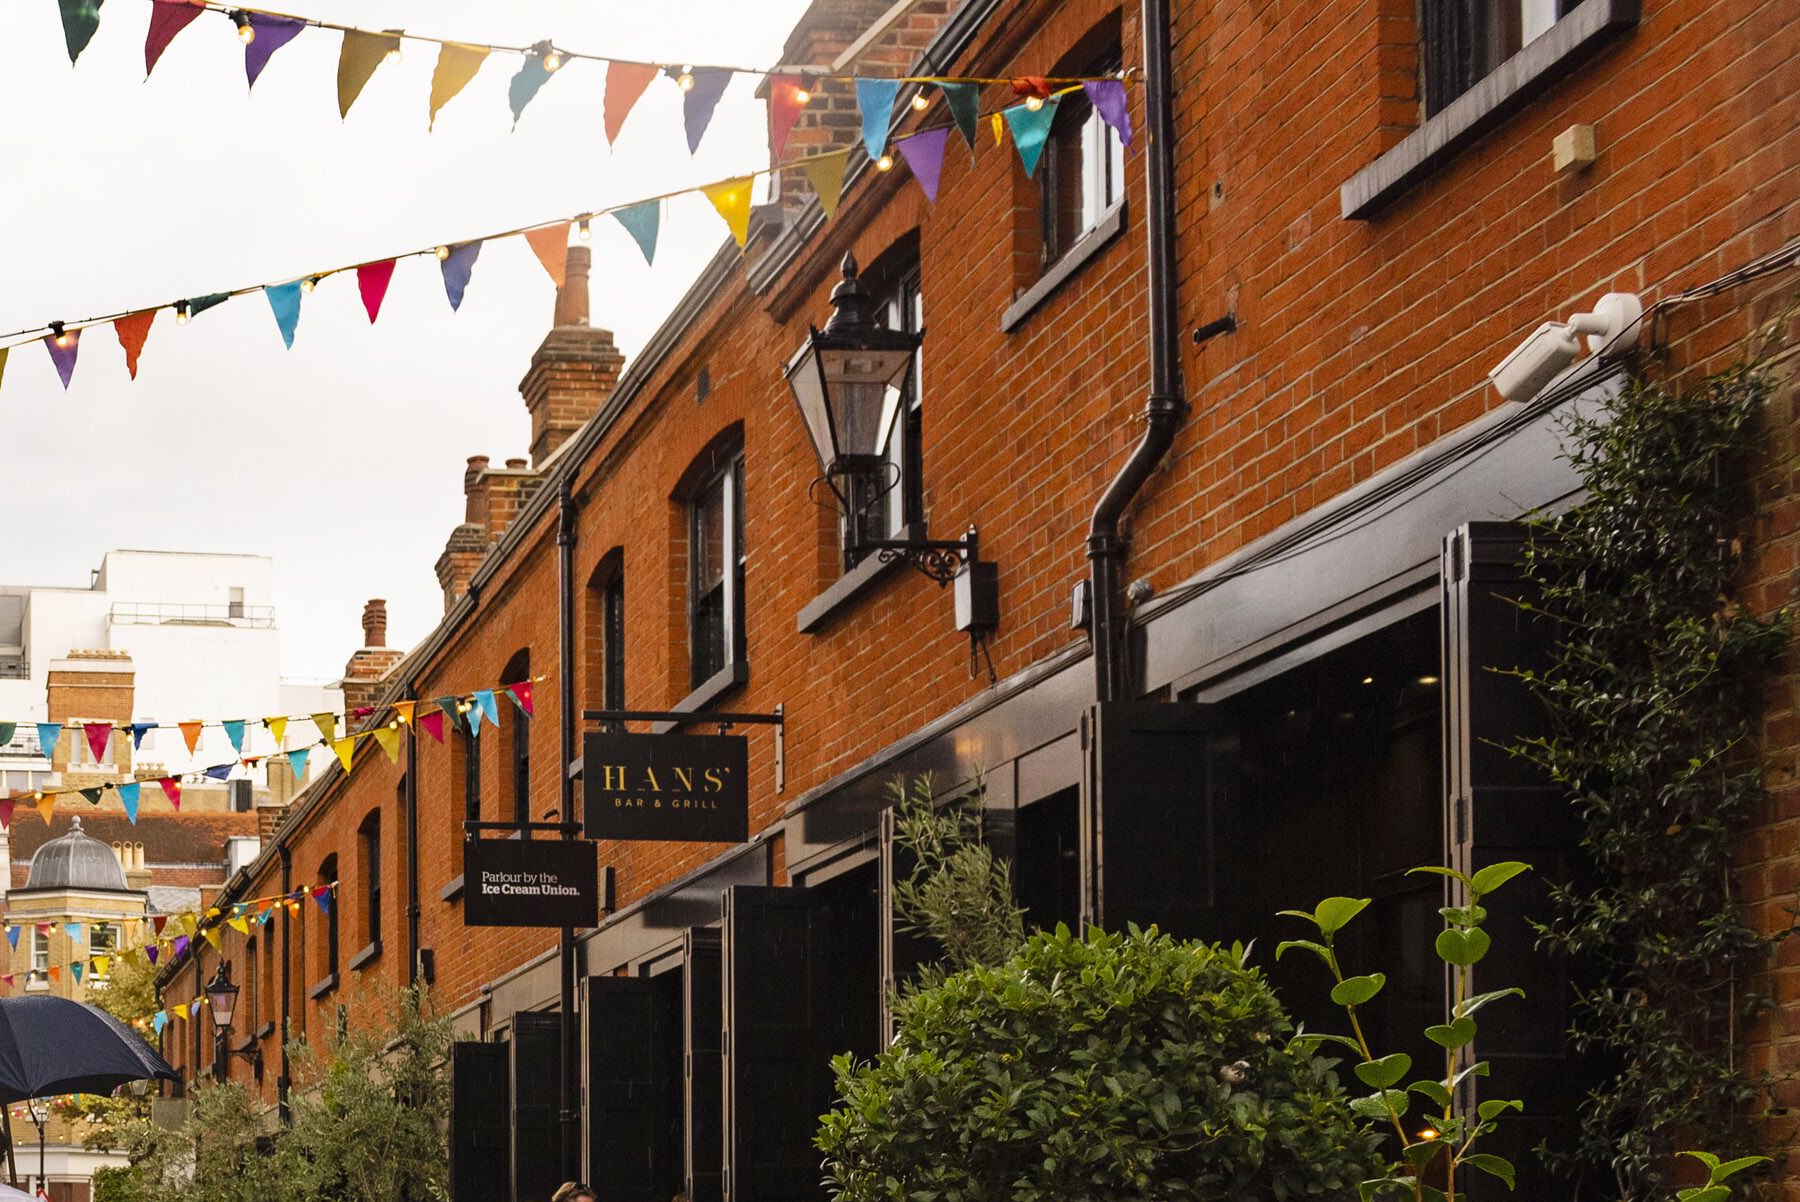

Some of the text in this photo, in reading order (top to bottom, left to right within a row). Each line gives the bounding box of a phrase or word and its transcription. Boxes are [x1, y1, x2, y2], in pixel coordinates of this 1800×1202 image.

[615, 798, 718, 809] BAR & GRILL
[482, 871, 558, 885] Parlour by the
[482, 883, 580, 896] Ice Cream Union.
